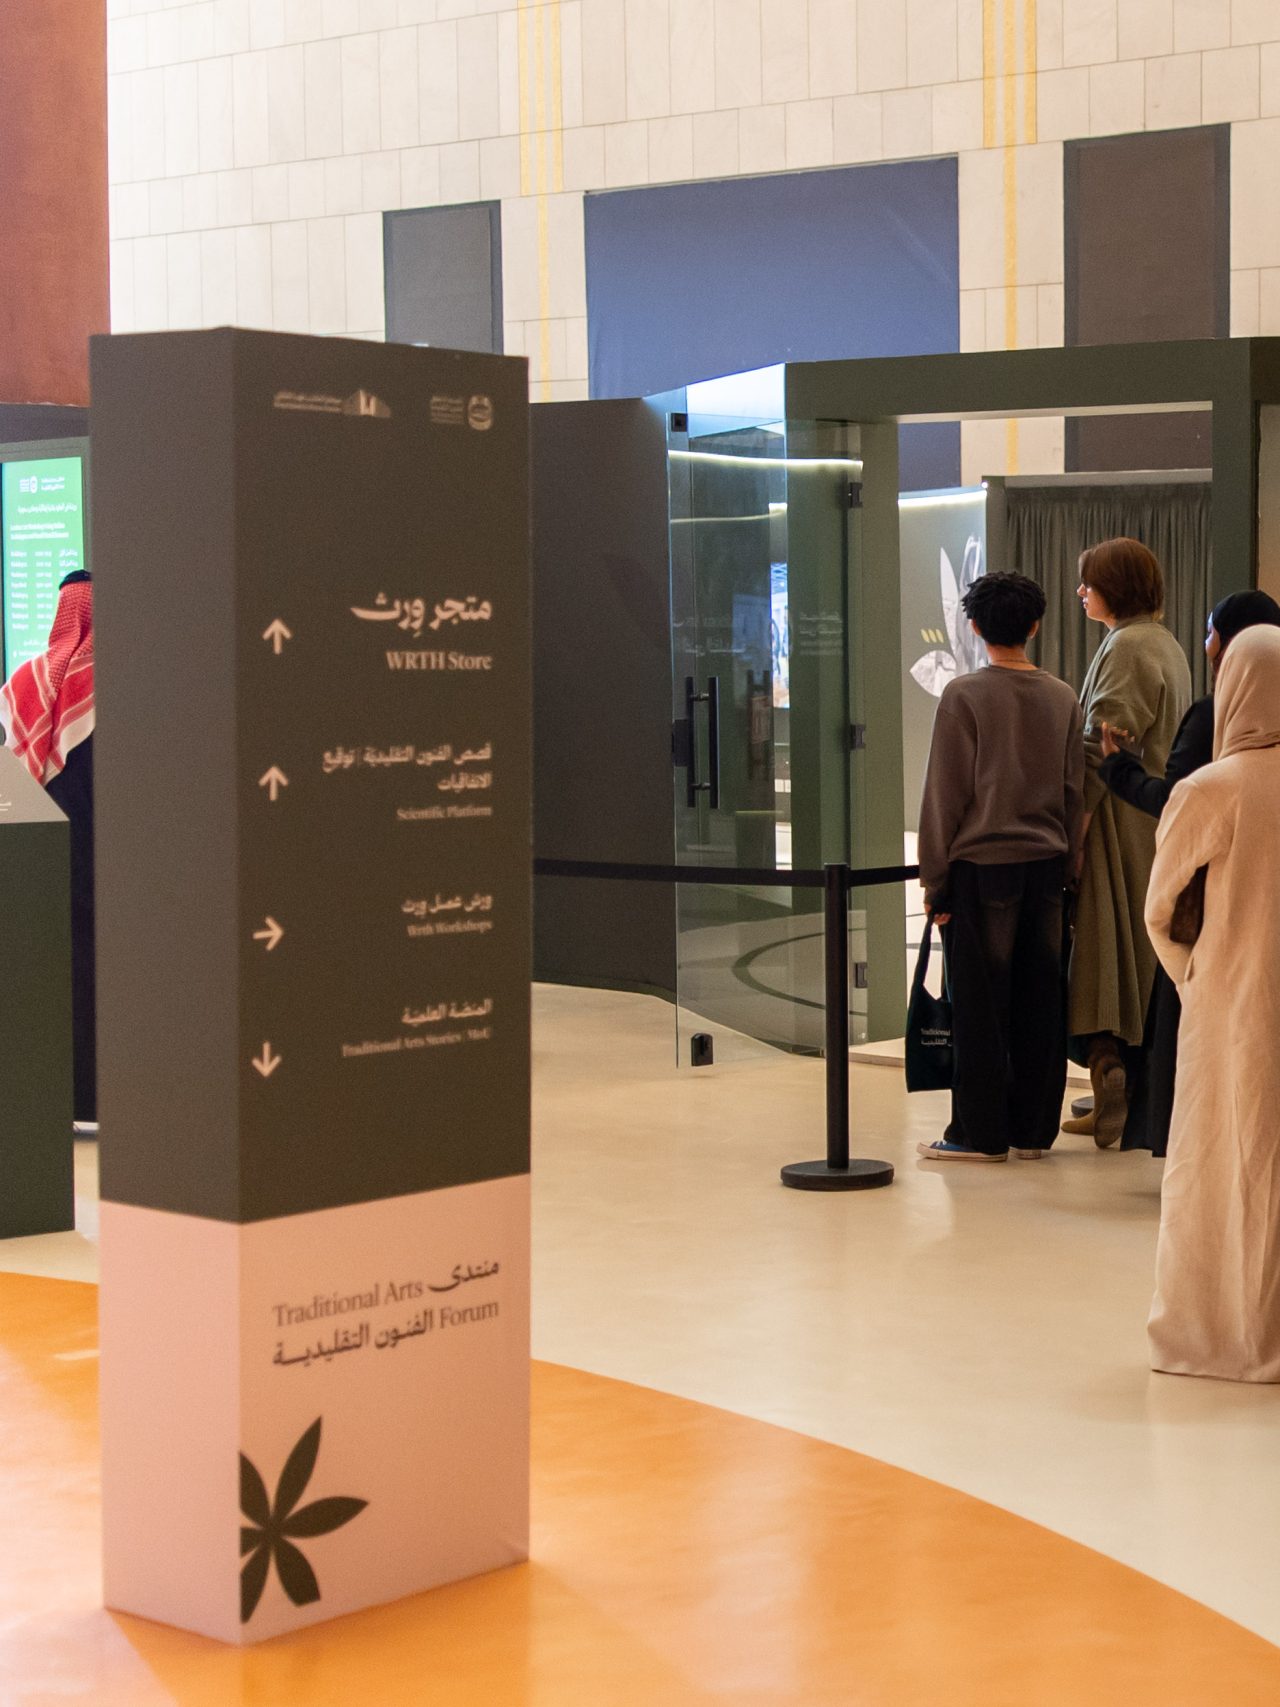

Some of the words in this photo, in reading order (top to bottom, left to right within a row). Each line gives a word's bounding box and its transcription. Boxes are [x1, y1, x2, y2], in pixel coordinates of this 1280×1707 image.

[429, 597, 492, 630] متجر
[386, 651, 446, 670] WRTH
[447, 652, 493, 670] Store
[322, 747, 355, 774] توقيع
[362, 746, 415, 767] التقليدية
[415, 745, 451, 766] الفنون
[396, 805, 444, 821] Scientific
[446, 805, 493, 819] Platform
[429, 895, 463, 914] عمل
[435, 920, 493, 935] Workshops
[401, 1002, 447, 1026] العلمية
[448, 998, 493, 1019] المنصة
[342, 1037, 402, 1057] Traditional
[403, 1037, 425, 1050] Arts
[428, 1261, 499, 1294] منتدى
[273, 1283, 381, 1327] Traditional
[384, 1280, 424, 1305] Arts
[439, 1302, 499, 1330] Forum
[374, 1308, 433, 1350] الفنون
